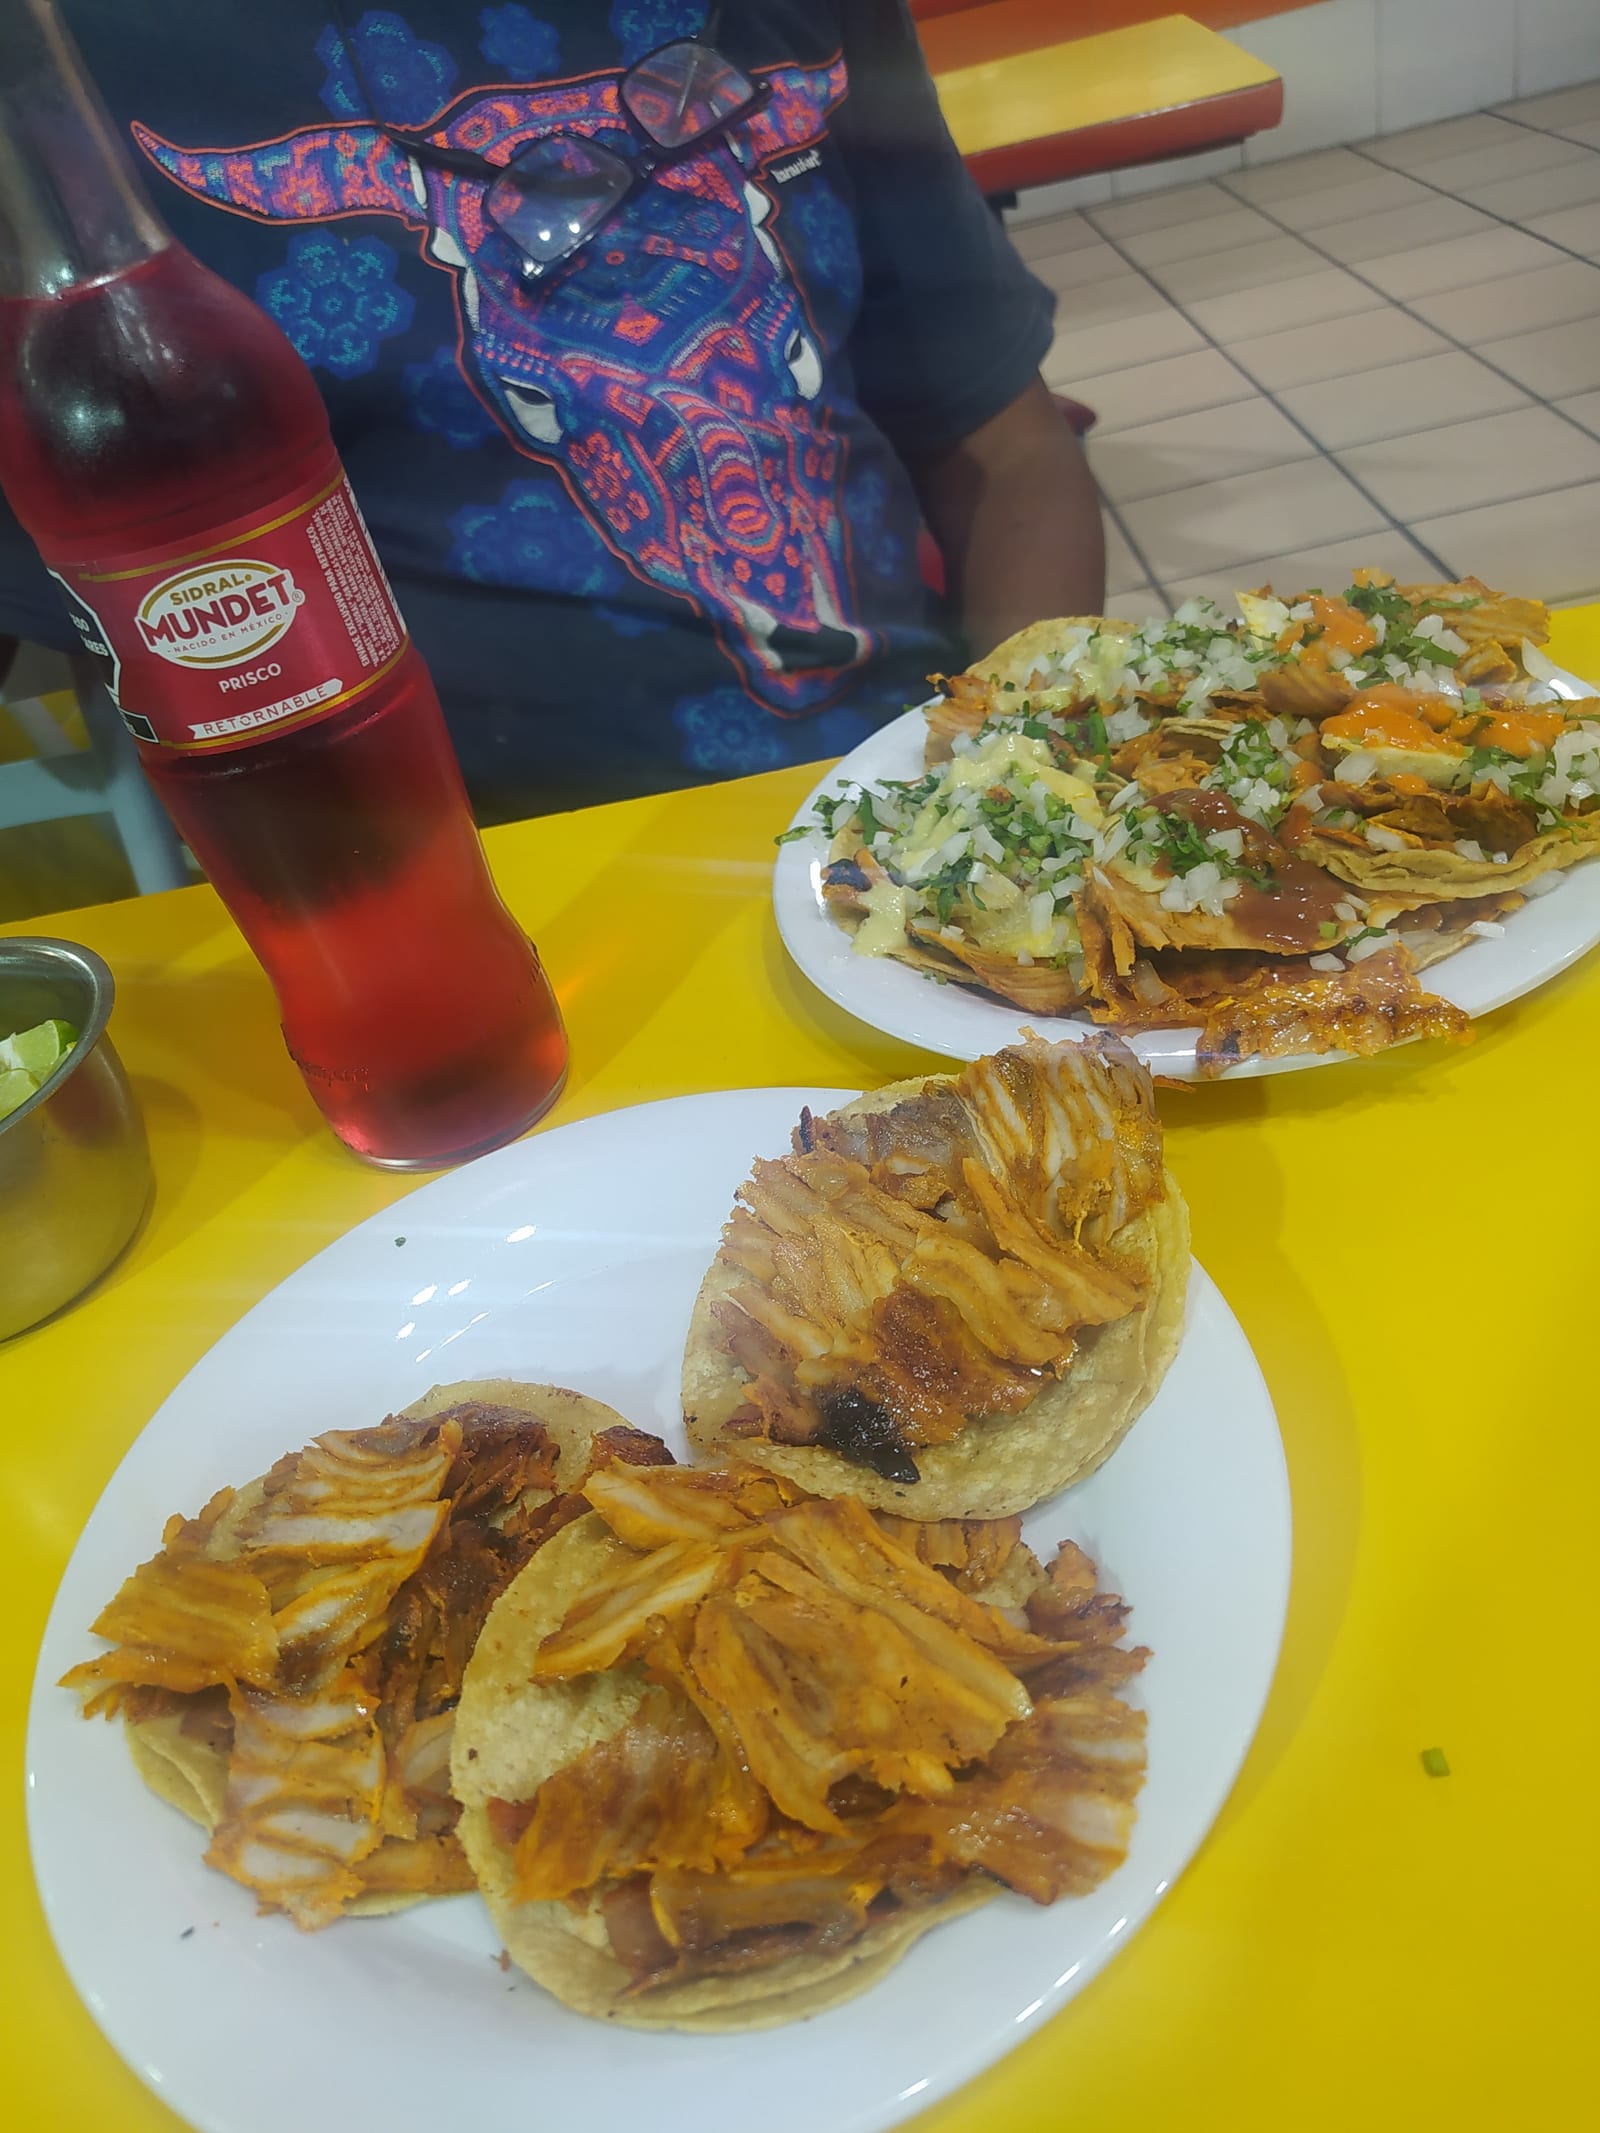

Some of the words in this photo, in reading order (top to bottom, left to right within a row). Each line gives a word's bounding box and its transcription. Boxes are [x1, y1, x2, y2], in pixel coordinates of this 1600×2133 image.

[323, 567, 340, 592] PARA
[139, 573, 291, 648] MUNDET
[333, 591, 358, 636] EXCLUSIVO
[174, 637, 216, 653] NACIDO
[221, 630, 236, 641] EN
[350, 634, 371, 667] ENVASE
[218, 662, 282, 693] PRISCO
[202, 685, 328, 735] RETORNABLE
